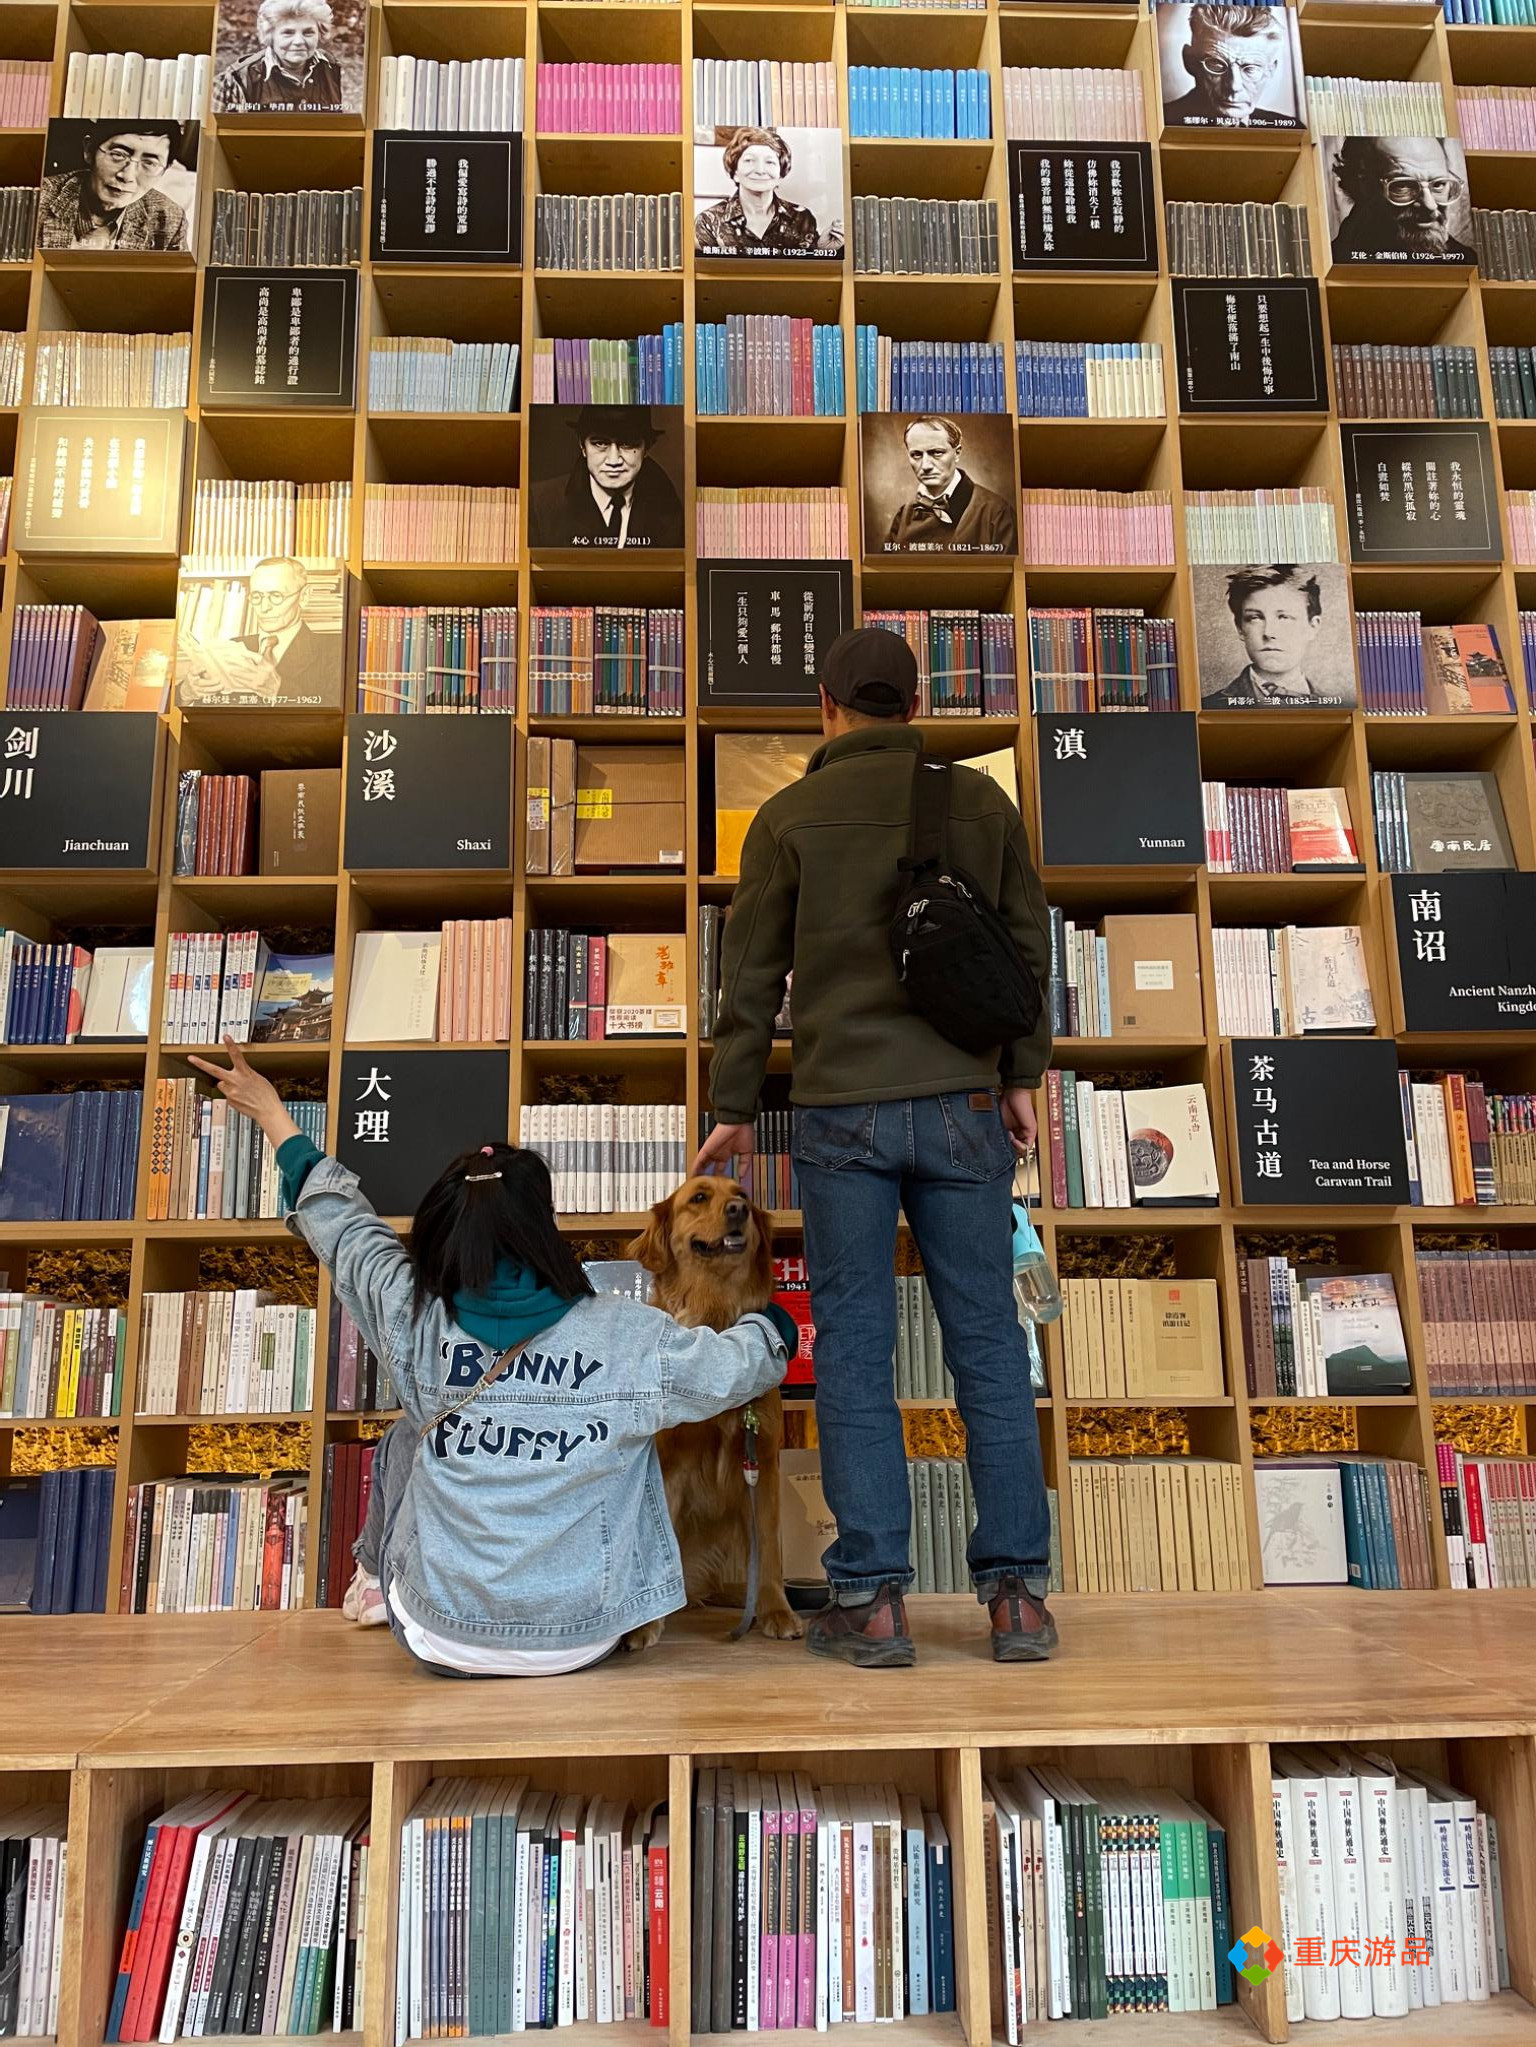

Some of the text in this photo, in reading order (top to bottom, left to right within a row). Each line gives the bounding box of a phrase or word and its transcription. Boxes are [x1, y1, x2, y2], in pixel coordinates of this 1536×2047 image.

[803, 590, 816, 675] 從前的日色變得慢
[1052, 727, 1087, 762] 滇
[0, 726, 40, 800] 剑川
[362, 728, 398, 802] 沙溪
[62, 838, 130, 853] Jianchuan
[456, 838, 493, 852] Shaxi
[1138, 836, 1186, 850] Yunnan
[1407, 888, 1447, 964] 南诏
[1448, 984, 1495, 998] Ancient
[354, 1066, 392, 1144] 大理
[1248, 1054, 1283, 1179] 茶马古道
[1309, 1157, 1390, 1171] Tea and Horse
[1315, 1174, 1393, 1188] Caravan Trail
[786, 1283, 807, 1291] 1943
